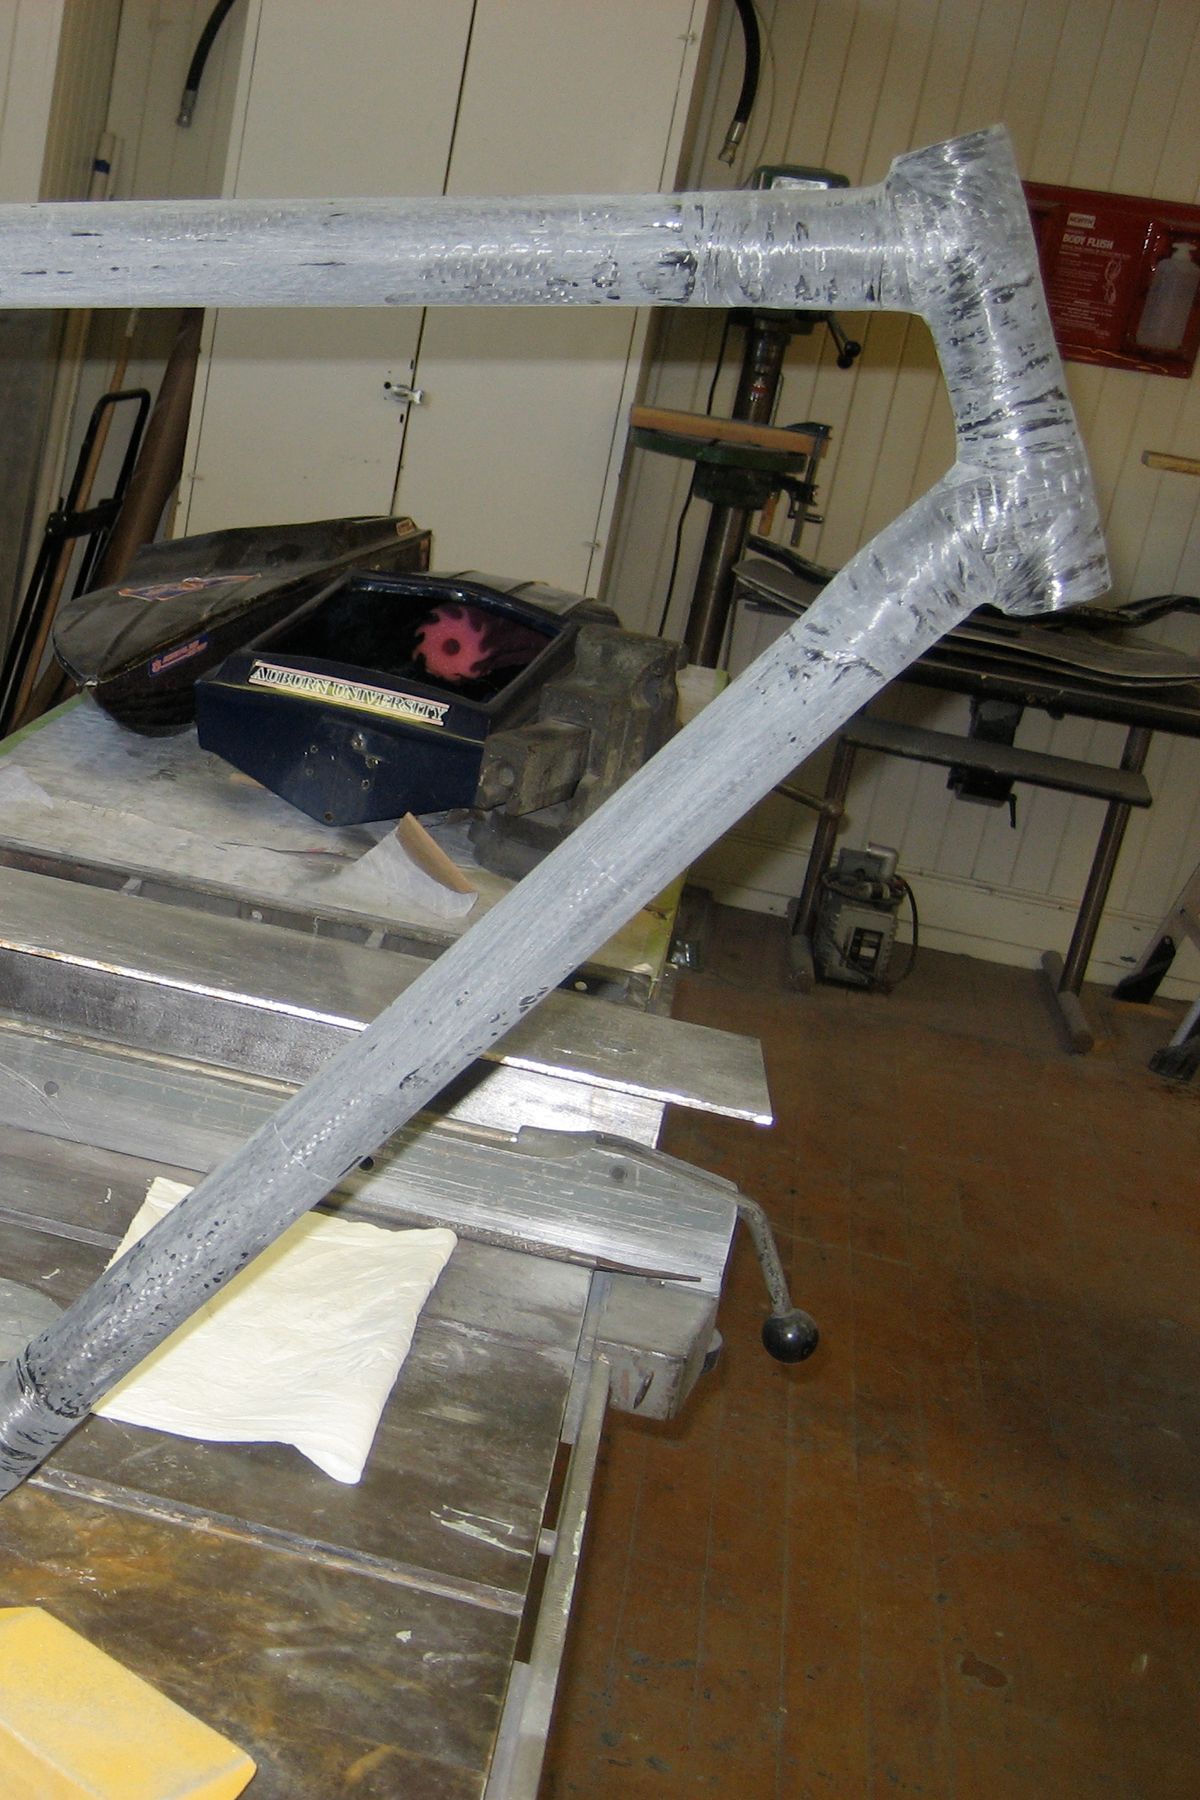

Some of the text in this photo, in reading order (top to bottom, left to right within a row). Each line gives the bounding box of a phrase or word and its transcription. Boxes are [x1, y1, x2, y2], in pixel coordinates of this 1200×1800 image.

[1062, 233, 1114, 250] BODY FLUSH
[251, 666, 449, 721] AUBURN UNIVERSITY
